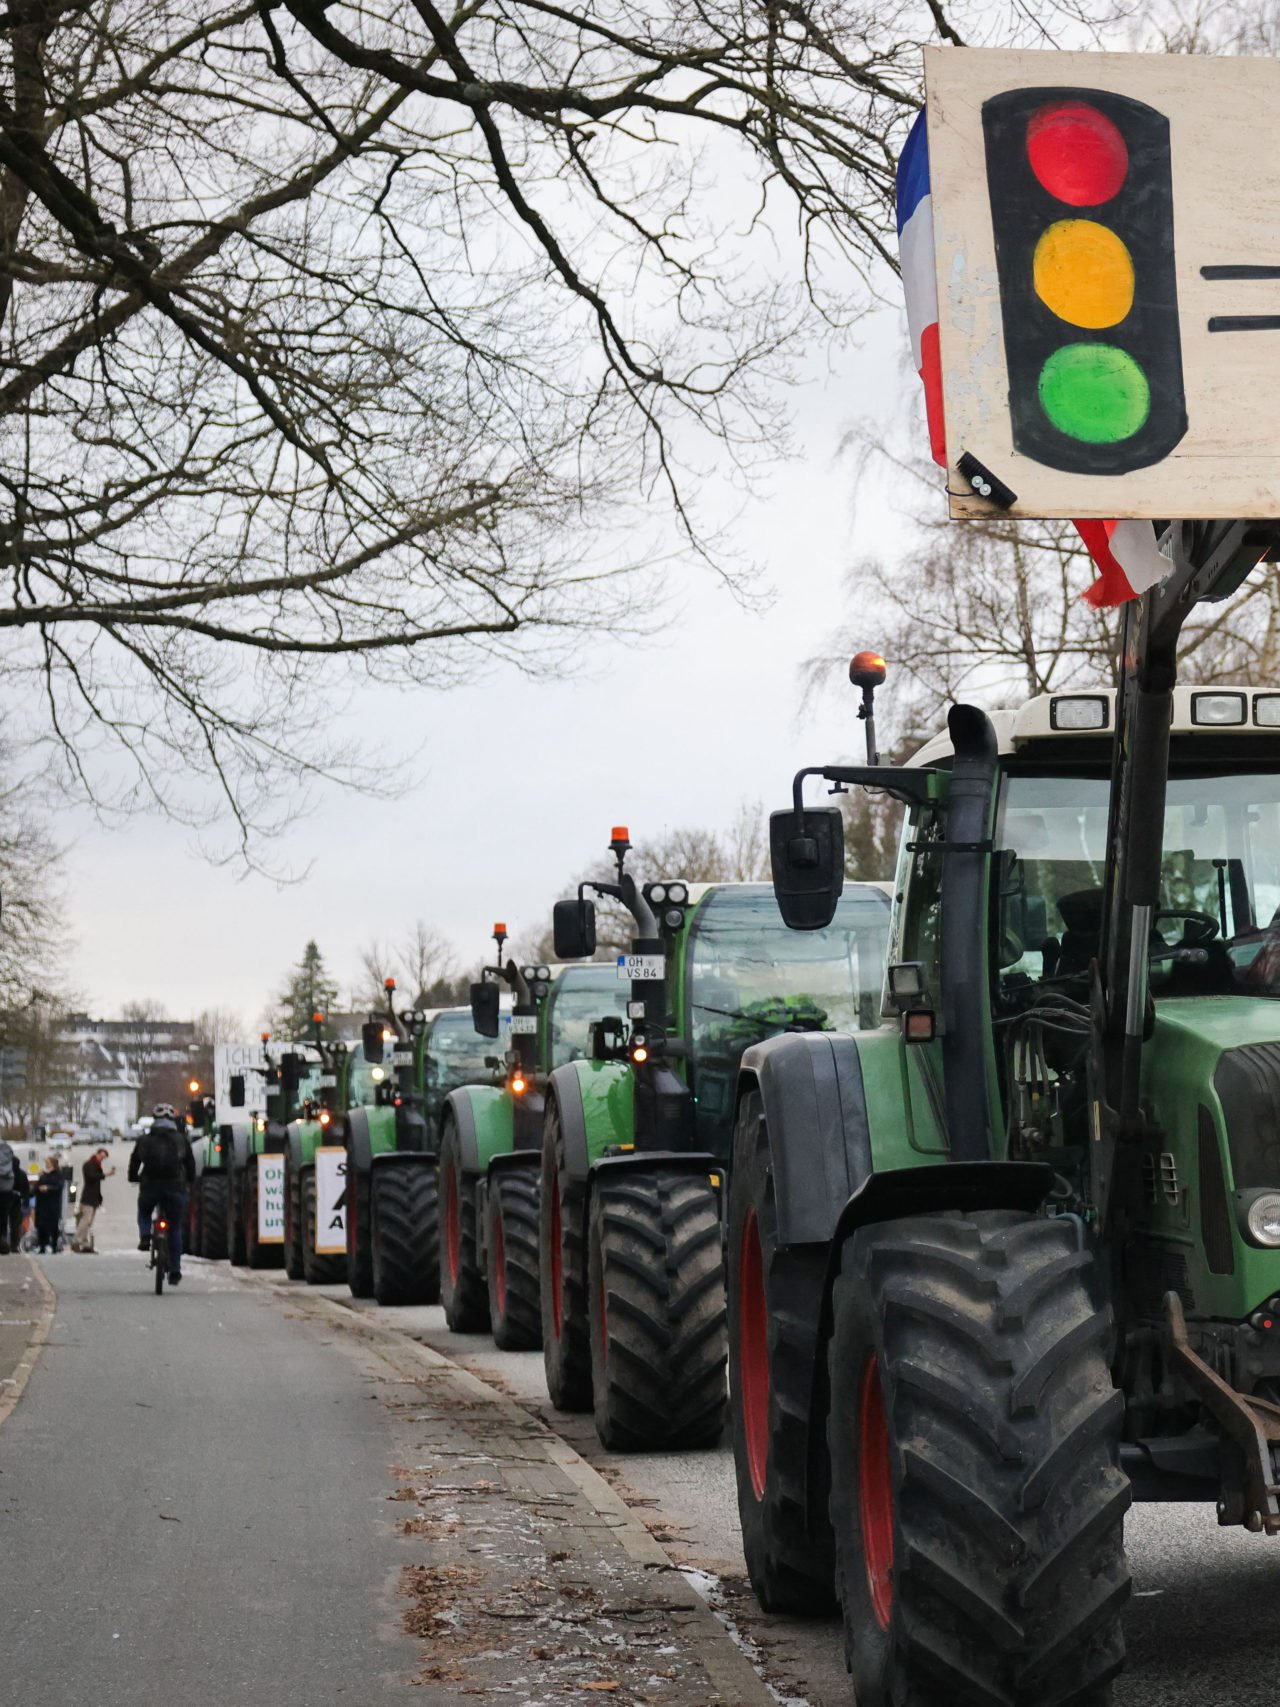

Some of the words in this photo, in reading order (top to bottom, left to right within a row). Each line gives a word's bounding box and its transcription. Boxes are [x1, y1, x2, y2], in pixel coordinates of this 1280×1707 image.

[628, 956, 643, 967] OH
[627, 968, 641, 978] VS
[643, 968, 657, 978] 84
[225, 1047, 251, 1065] ICH
